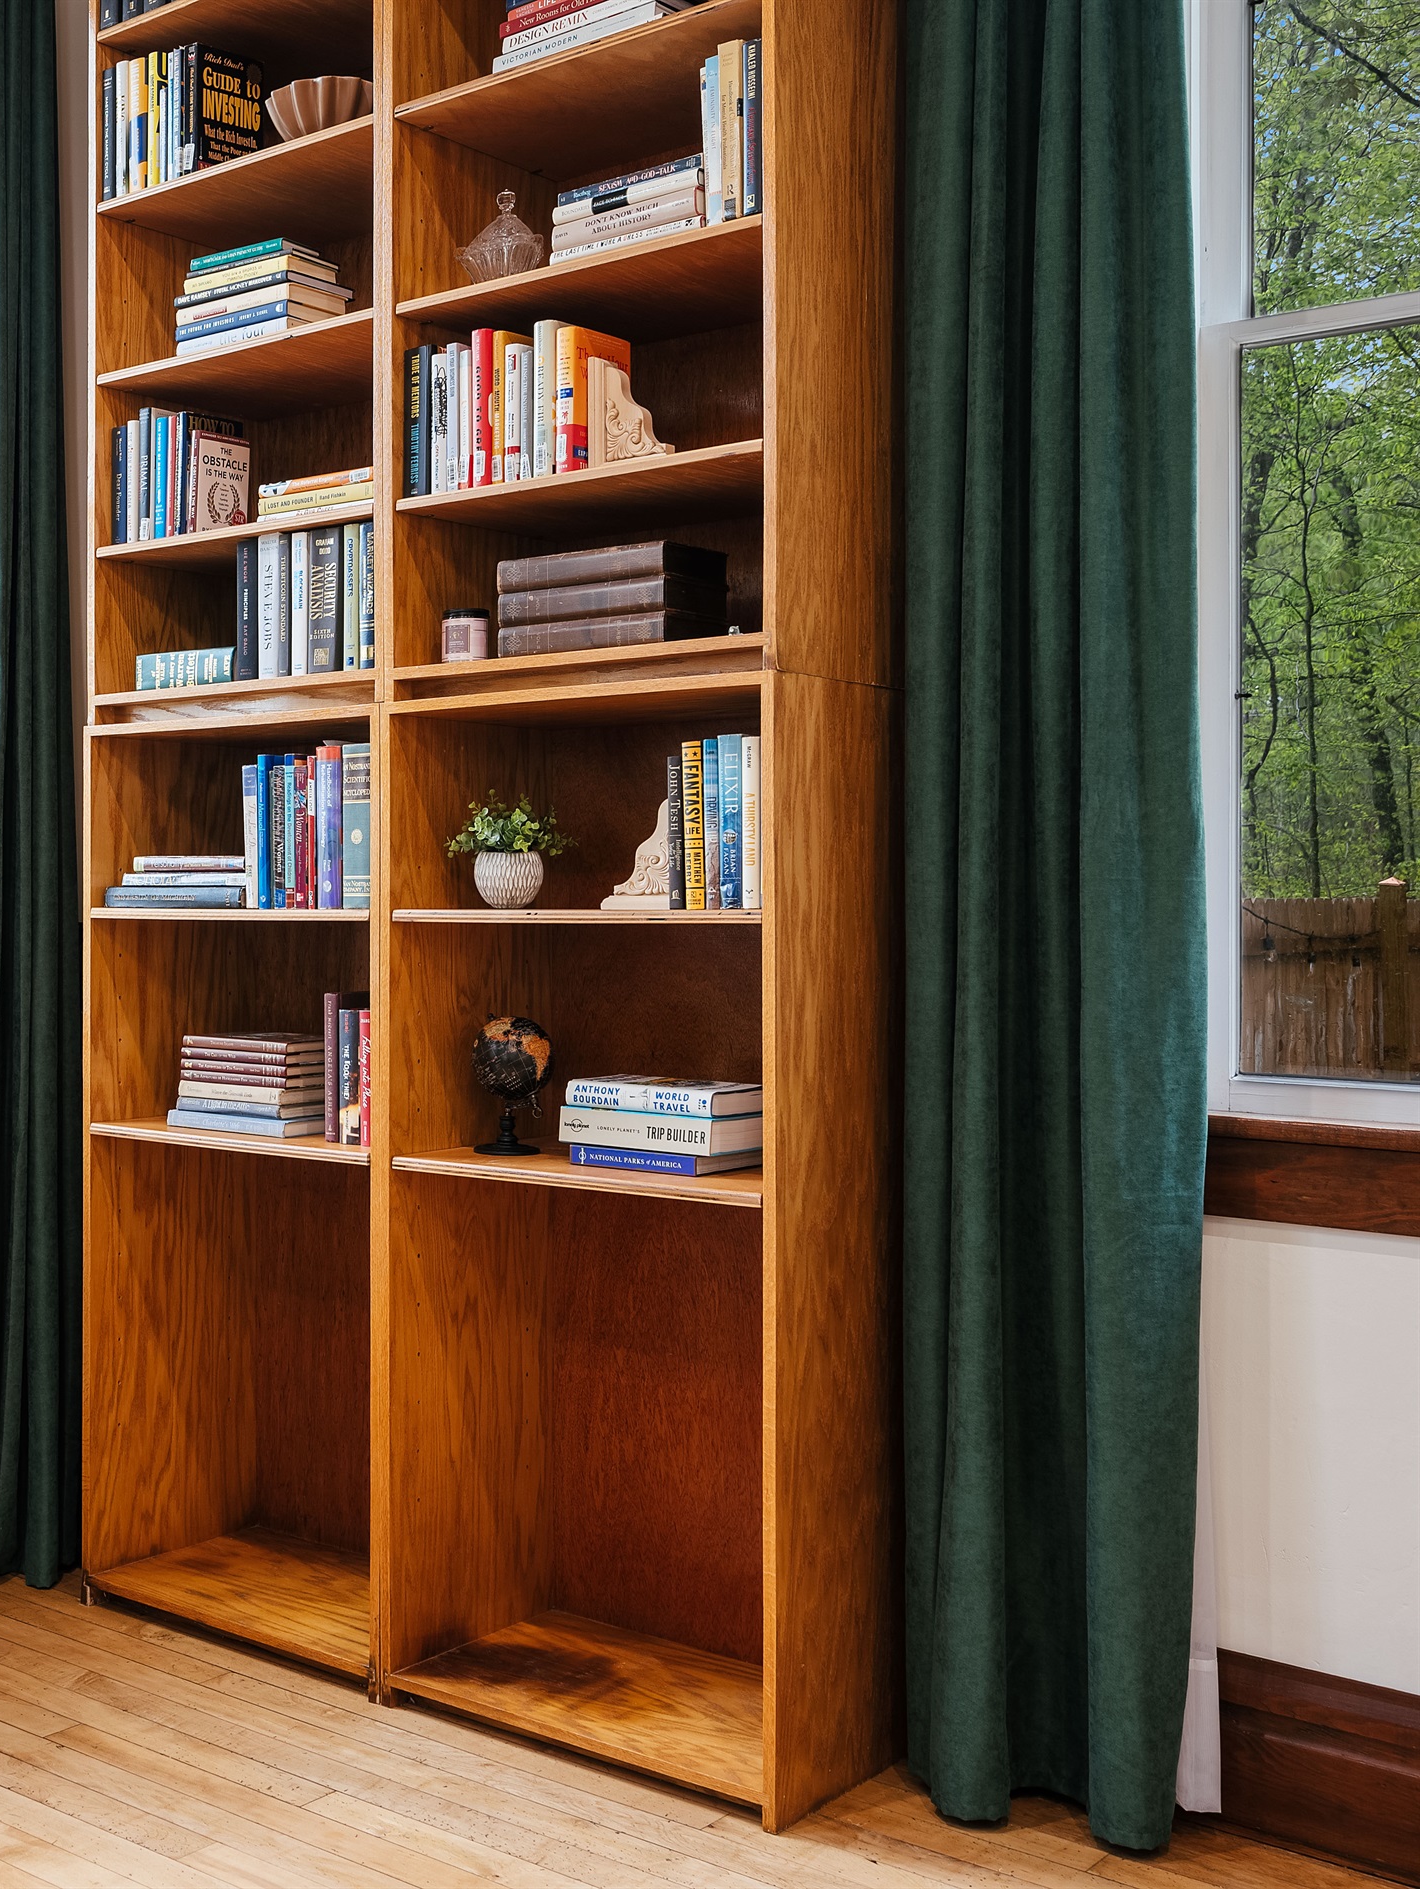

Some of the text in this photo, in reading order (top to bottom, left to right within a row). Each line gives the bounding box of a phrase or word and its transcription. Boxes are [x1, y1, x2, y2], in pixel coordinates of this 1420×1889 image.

[519, 3, 570, 28] New Rooms for
[509, 25, 550, 48] DESIGN
[550, 11, 589, 33] REMIX
[204, 52, 245, 72] Rich Dad's
[501, 34, 579, 66] VICTORIAN MODERN
[203, 67, 261, 100] GUIDE to
[747, 44, 756, 101] KHALED HOSSEINI
[202, 88, 261, 132] INVESTING
[204, 124, 250, 148] What the Rich Invest
[728, 112, 737, 144] Clinical
[208, 150, 224, 163] Middle
[210, 141, 242, 156] That the Poor
[727, 144, 737, 180] Sexuality
[584, 202, 660, 228] DON'T KNOW MUCH
[591, 213, 652, 235] ABOUT HISTORY
[553, 243, 595, 260] THE LAST TIME
[177, 281, 249, 305] DAVE RAMSEY MONEY
[187, 325, 203, 334] FUTURE
[203, 322, 212, 330] FOR
[212, 317, 235, 328] INVESTORS
[411, 354, 420, 419] TRIBE OF MENTORS
[189, 415, 235, 437] HOW TO
[475, 406, 482, 423] TO
[202, 454, 248, 473] OBSTACLE
[220, 447, 233, 457] THE
[410, 423, 420, 484] TIMOTHY FERRISS
[140, 455, 149, 493] PRIMAL
[205, 467, 244, 483] IS THE WAY
[300, 478, 318, 486] Referral
[318, 476, 334, 485] Engine
[267, 491, 346, 510] LOST AND FOUNDER Rand Fishkin
[366, 531, 374, 615] MARKET WIZARDS
[310, 565, 324, 621] ANALYSIS
[324, 562, 337, 619] SECURITY
[263, 564, 273, 651] STEVE JOBS
[176, 653, 185, 688] Warren
[186, 652, 196, 687] Buffett
[326, 799, 333, 808] of
[669, 764, 681, 832] JOHN TESH
[683, 764, 701, 825] FANTASY
[258, 803, 266, 831] Manual
[705, 796, 717, 829] DRYING
[723, 752, 738, 873] ELIXIR BRIAN
[744, 799, 756, 841] THIRSTY
[247, 819, 256, 860] Last Dance
[295, 811, 305, 844] Women
[685, 826, 701, 835] LIFE
[276, 842, 284, 873] Women
[722, 847, 730, 875] FAGAN
[744, 841, 756, 867] LAND
[693, 851, 702, 885] MATTHEW
[360, 1035, 371, 1065] Falling
[342, 1060, 351, 1081] BOOK
[362, 1066, 370, 1085] into
[342, 1082, 351, 1101] THIEF
[361, 1086, 371, 1109] Place
[573, 1084, 621, 1097] ANTHONY
[573, 1094, 620, 1107] BOURDAIN
[654, 1091, 690, 1103] WORLD
[207, 1099, 222, 1110] Light
[653, 1101, 691, 1114] TRAVEL
[564, 1121, 590, 1130] lonely planet
[646, 1126, 706, 1145] TRIP BUILDER
[589, 1153, 682, 1170] NATIONAL PARKS of AMERICA
